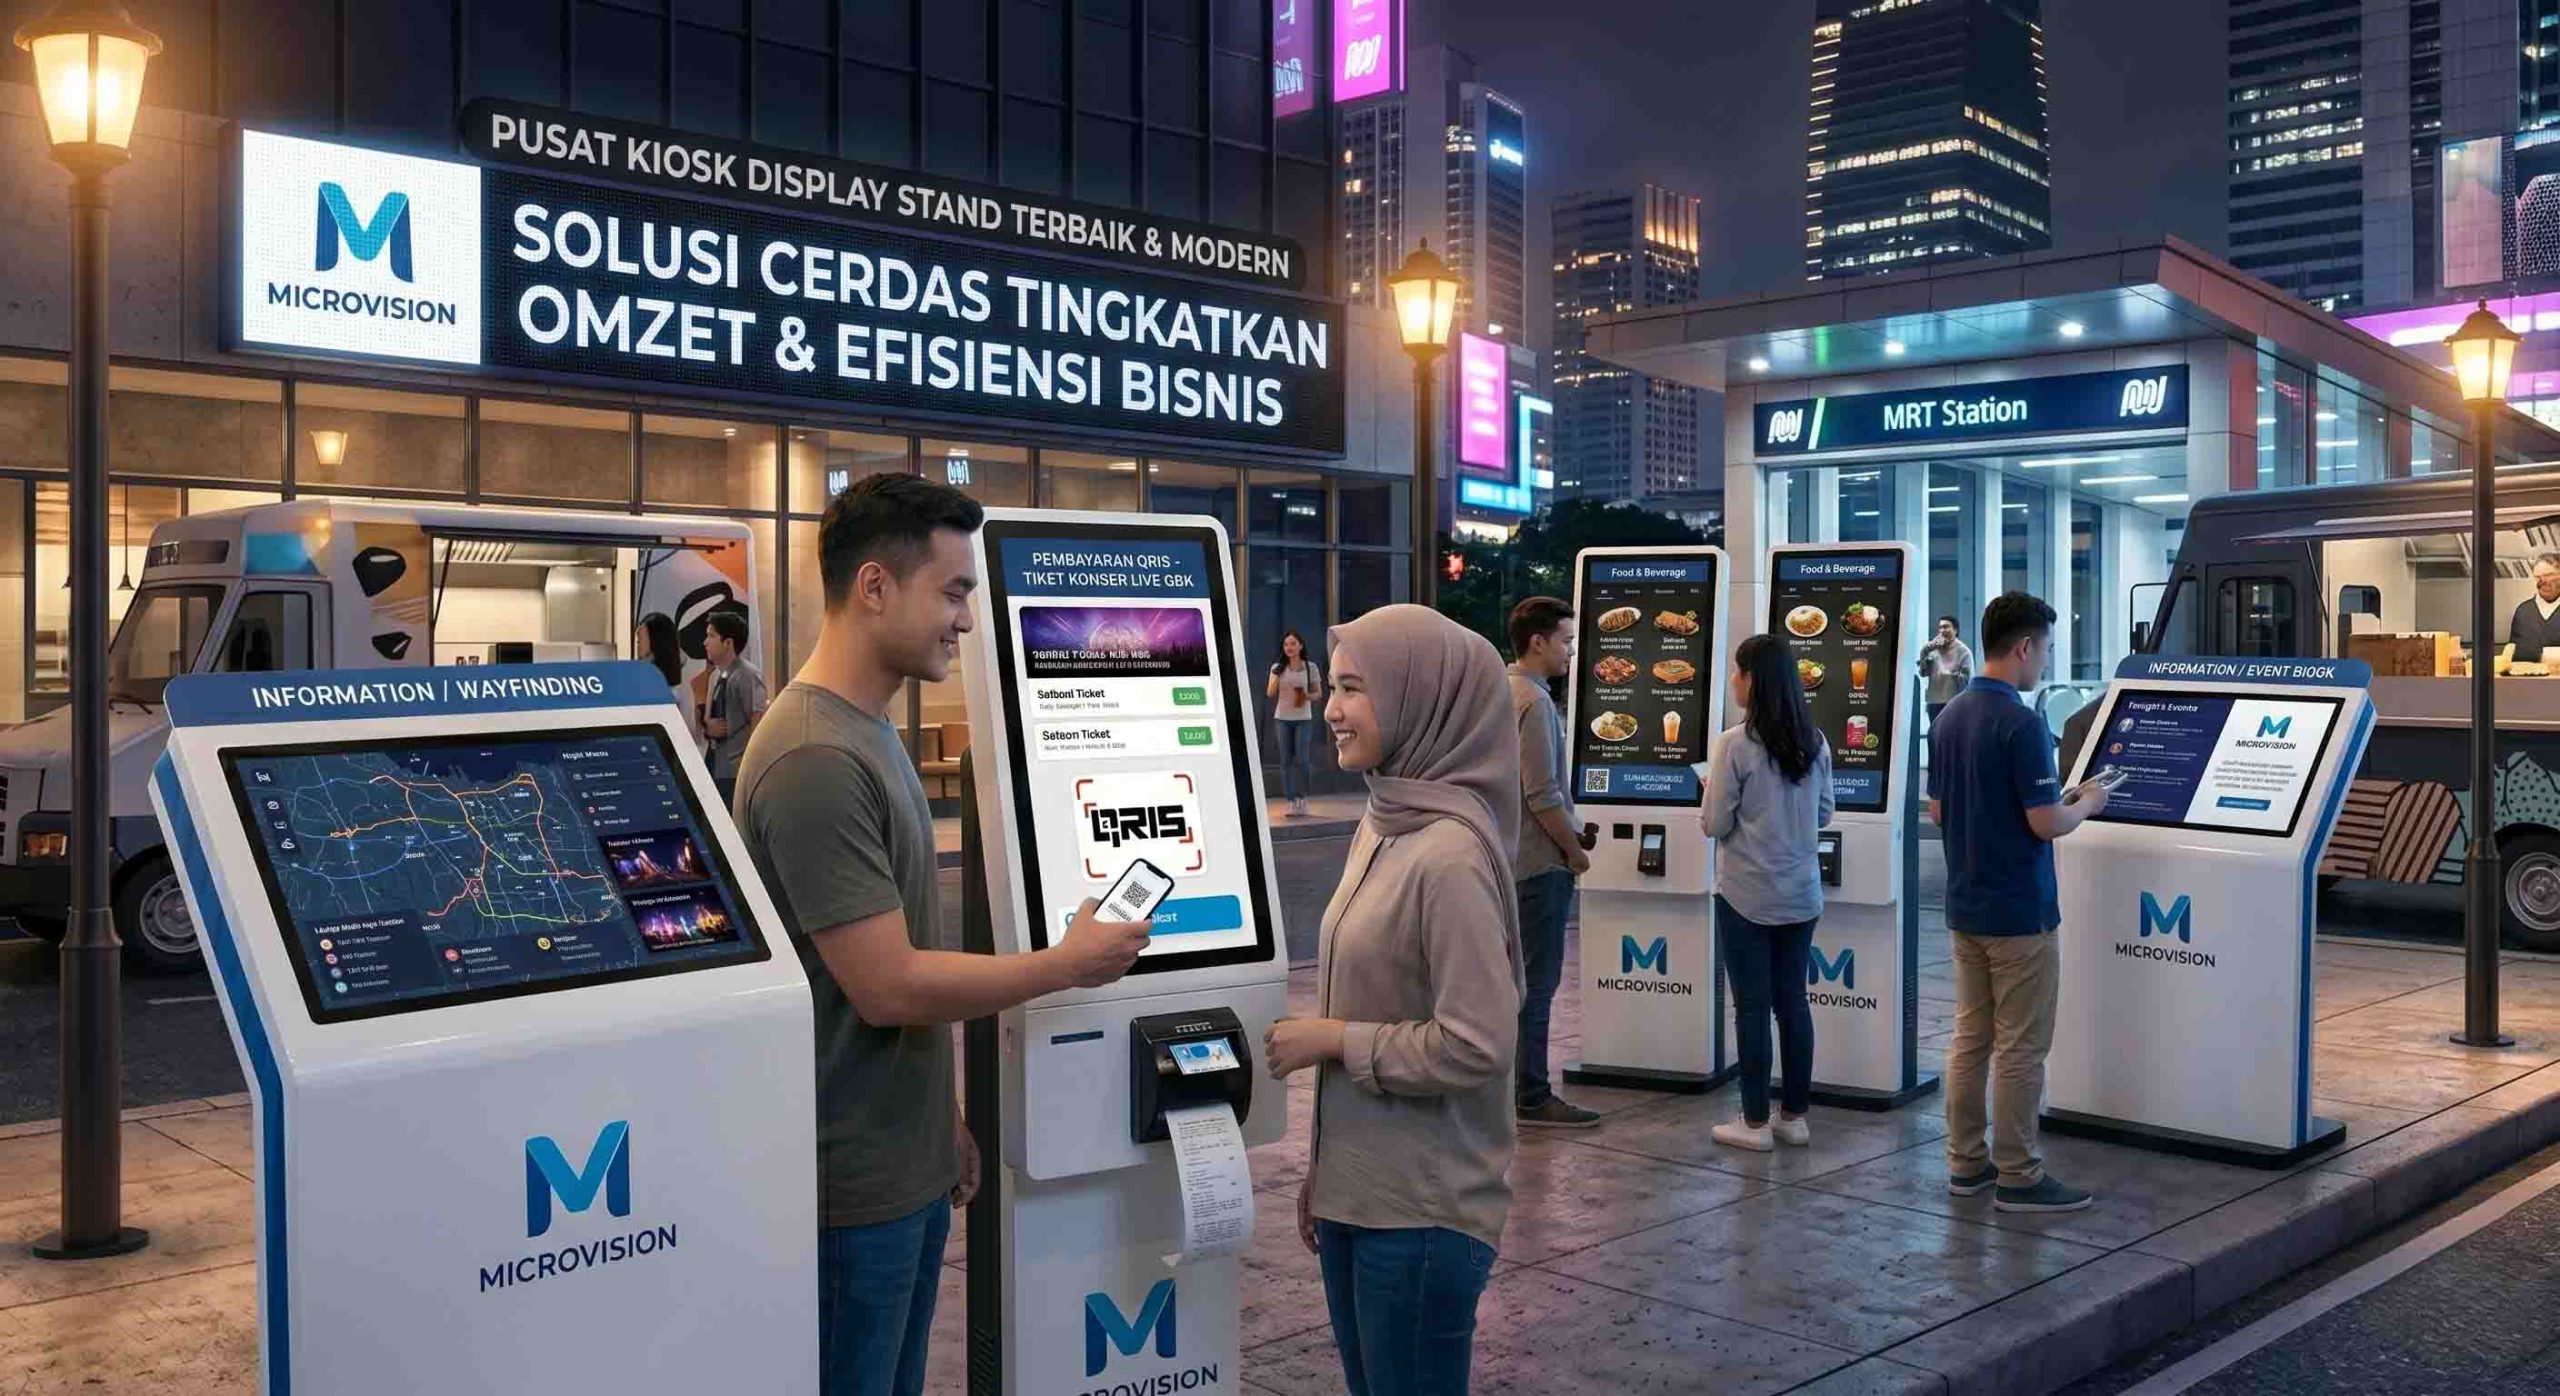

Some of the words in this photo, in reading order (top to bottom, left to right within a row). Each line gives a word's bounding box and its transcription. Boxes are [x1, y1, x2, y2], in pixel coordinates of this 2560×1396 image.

[491, 113, 617, 167] PUSAT
[627, 138, 738, 188] KIOSK
[748, 158, 888, 212] DISPLAY
[897, 183, 1002, 231] STAND
[1010, 203, 1137, 254] TERBAIK
[1144, 225, 1162, 257] &
[1172, 232, 1290, 279] MODERN
[512, 203, 738, 288] SOLUSI
[759, 240, 992, 322] CERDAS
[1006, 275, 1328, 369] TINGKATKAN
[268, 281, 456, 326] MICROVISION
[518, 284, 757, 365] OMZET
[774, 315, 816, 375] &
[837, 323, 1101, 406] EFISIENSI
[1122, 360, 1284, 426] BISNIS
[1884, 401, 1937, 431] MRT
[1942, 396, 2027, 427] Station
[1033, 553, 1134, 567] PEMBAYARAN
[1137, 554, 1171, 569] QRIS
[1800, 564, 1823, 574] Food
[1825, 564, 1831, 574] &
[1833, 564, 1876, 575] Beverage
[1022, 572, 1064, 586] TIKET
[1069, 572, 1128, 586] KONSER
[1131, 574, 1161, 587] LIVE
[1164, 574, 1194, 587] GBK
[1611, 568, 1634, 577] Food
[1635, 568, 1642, 577] &
[1644, 567, 1687, 579] Beverage
[2149, 662, 2236, 676] INFORMATION
[2237, 664, 2245, 677] /
[2247, 664, 2291, 677] EVENT
[252, 681, 436, 709] INFORMATION
[456, 675, 604, 699] WAYFINDING
[1075, 689, 1105, 699] Ticket
[1081, 729, 1111, 740] Ticket
[2235, 740, 2297, 750] MICROVISION
[1090, 805, 1187, 848] QRIS
[2115, 943, 2216, 967] MICROVISION
[1597, 977, 1692, 995] MICROVISION
[1807, 993, 1877, 1010] ROVISION
[480, 1223, 677, 1293] MICROVISION
